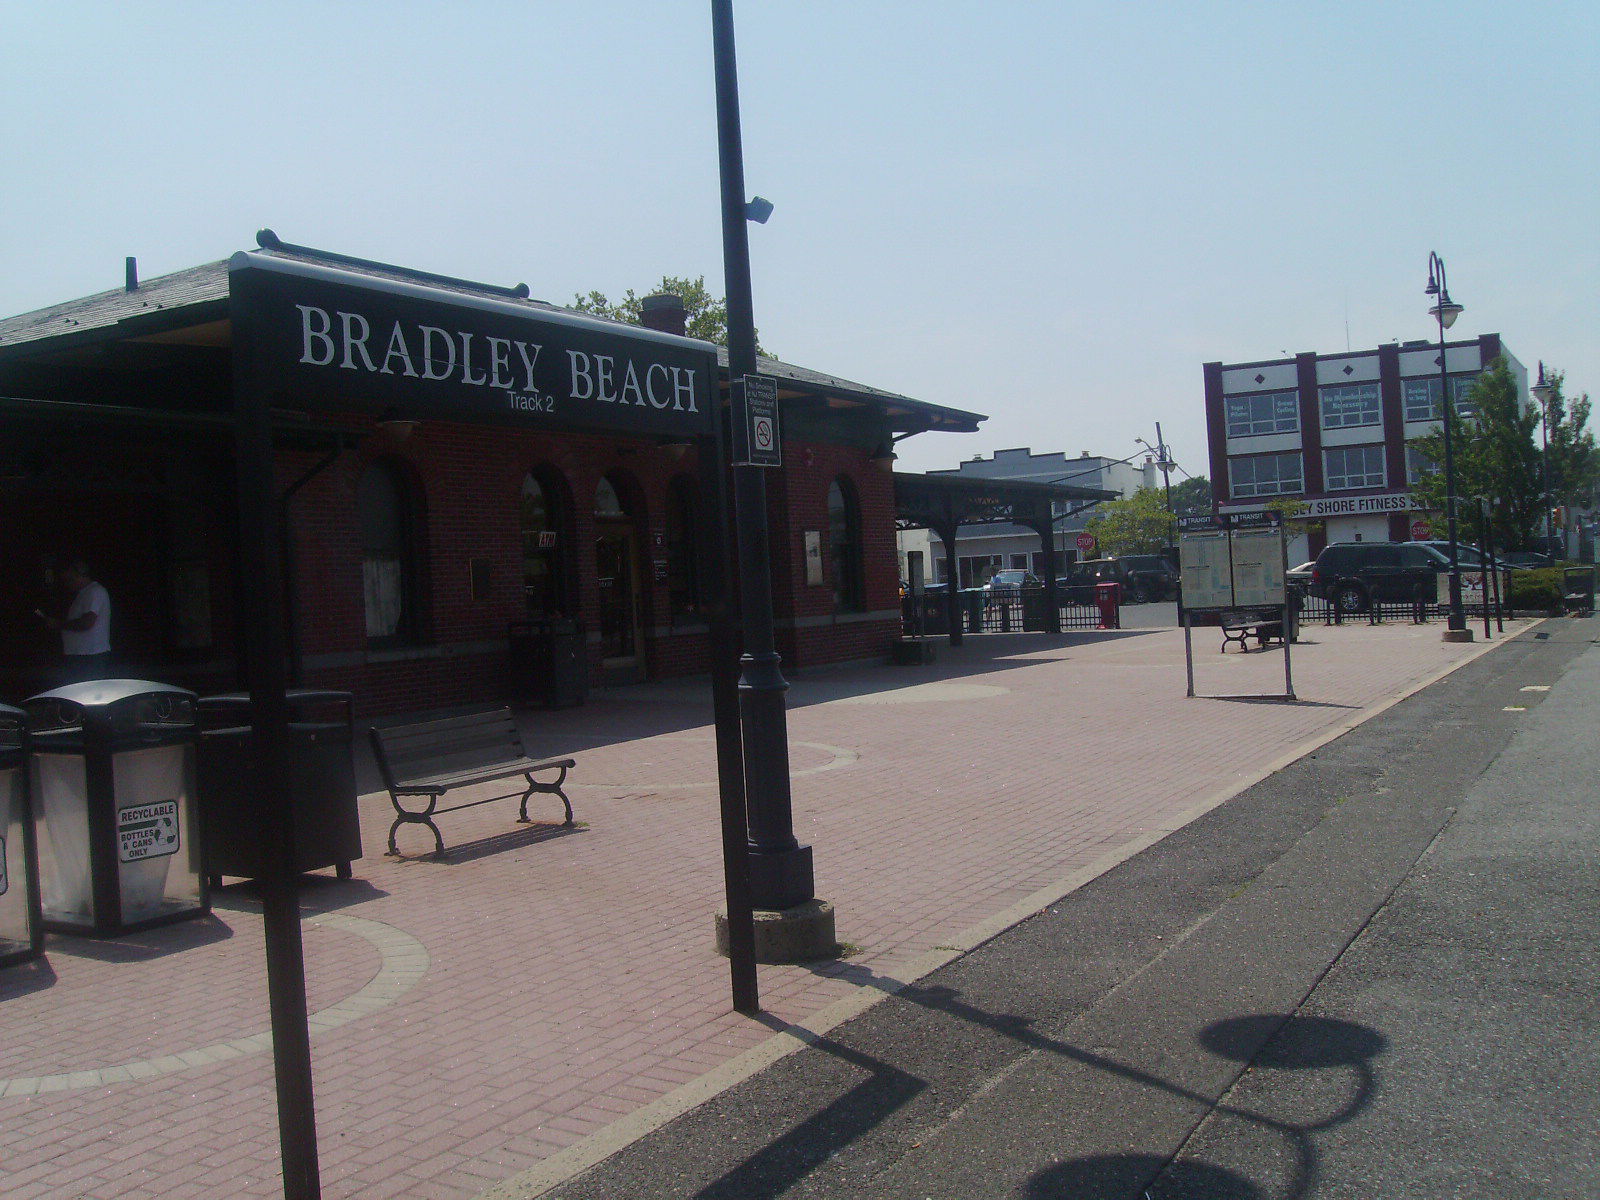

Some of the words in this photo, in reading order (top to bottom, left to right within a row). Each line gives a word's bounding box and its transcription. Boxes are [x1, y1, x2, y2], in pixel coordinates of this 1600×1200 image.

[296, 304, 543, 393] BRADLEY
[566, 349, 699, 413] BEACH
[507, 391, 543, 412] Track
[546, 395, 554, 412] 2
[1317, 500, 1355, 514] SHORE
[1358, 496, 1406, 511] FITNESS
[1187, 516, 1211, 524] TRANSIT
[1239, 512, 1264, 520] TRANSIT
[1412, 525, 1428, 536] STOP
[1077, 538, 1093, 546] STOP
[121, 805, 174, 822] RECYCLABLE
[121, 829, 154, 842] BOTTLES
[132, 838, 153, 848] CANS
[129, 848, 148, 857] ONLY
